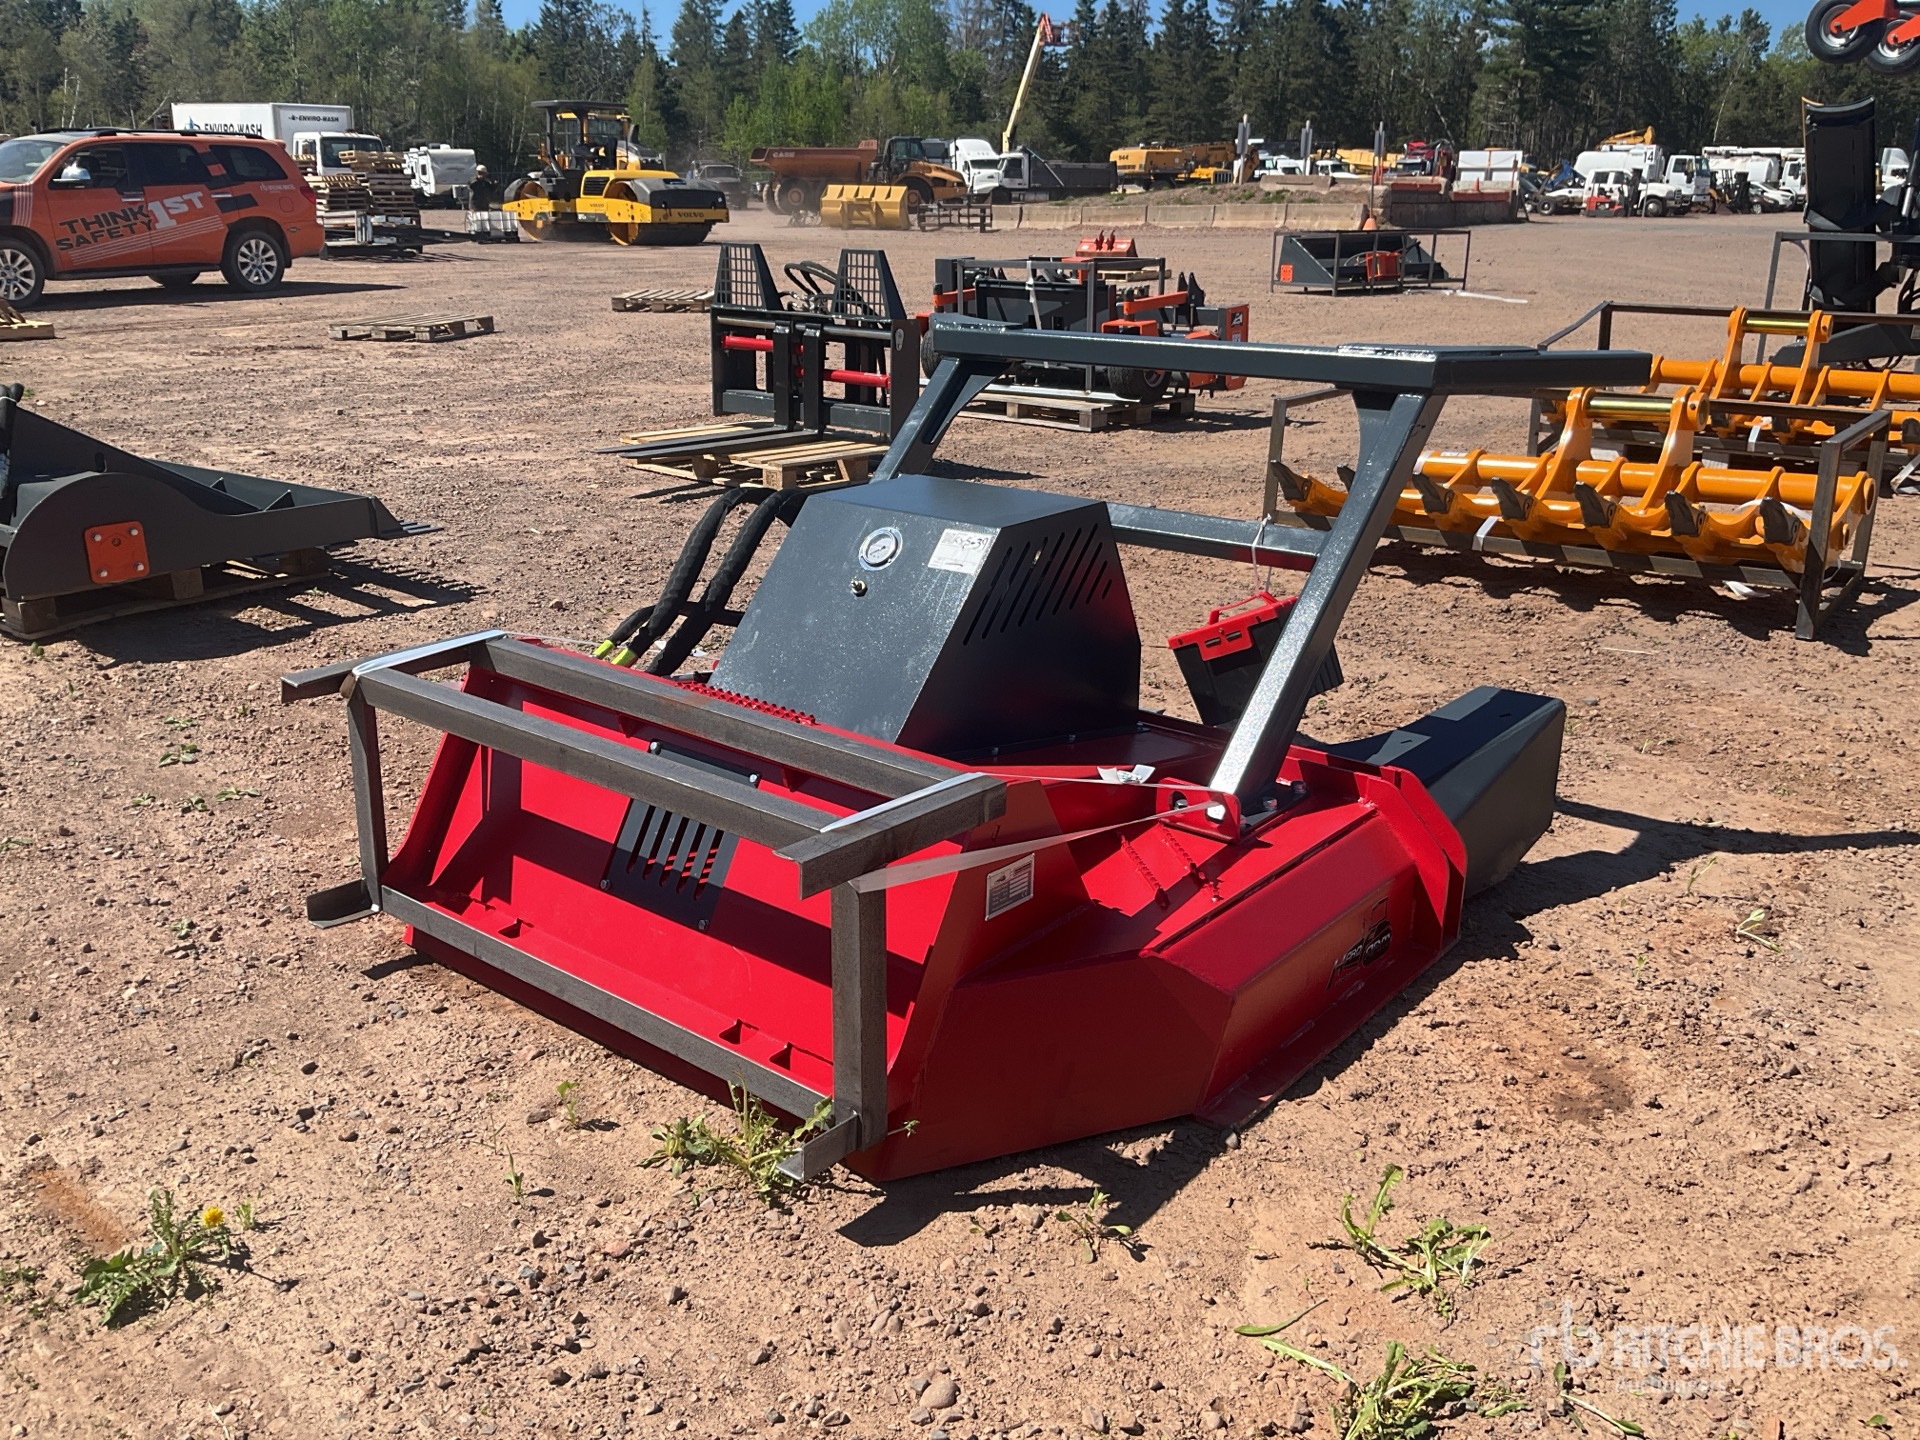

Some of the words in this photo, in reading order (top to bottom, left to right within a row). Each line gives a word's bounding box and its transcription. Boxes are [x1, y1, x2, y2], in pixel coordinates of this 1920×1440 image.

[1643, 151, 1654, 163] 14
[59, 204, 151, 234] THINK
[147, 191, 204, 230] 1ST
[55, 219, 153, 251] SAFETY
